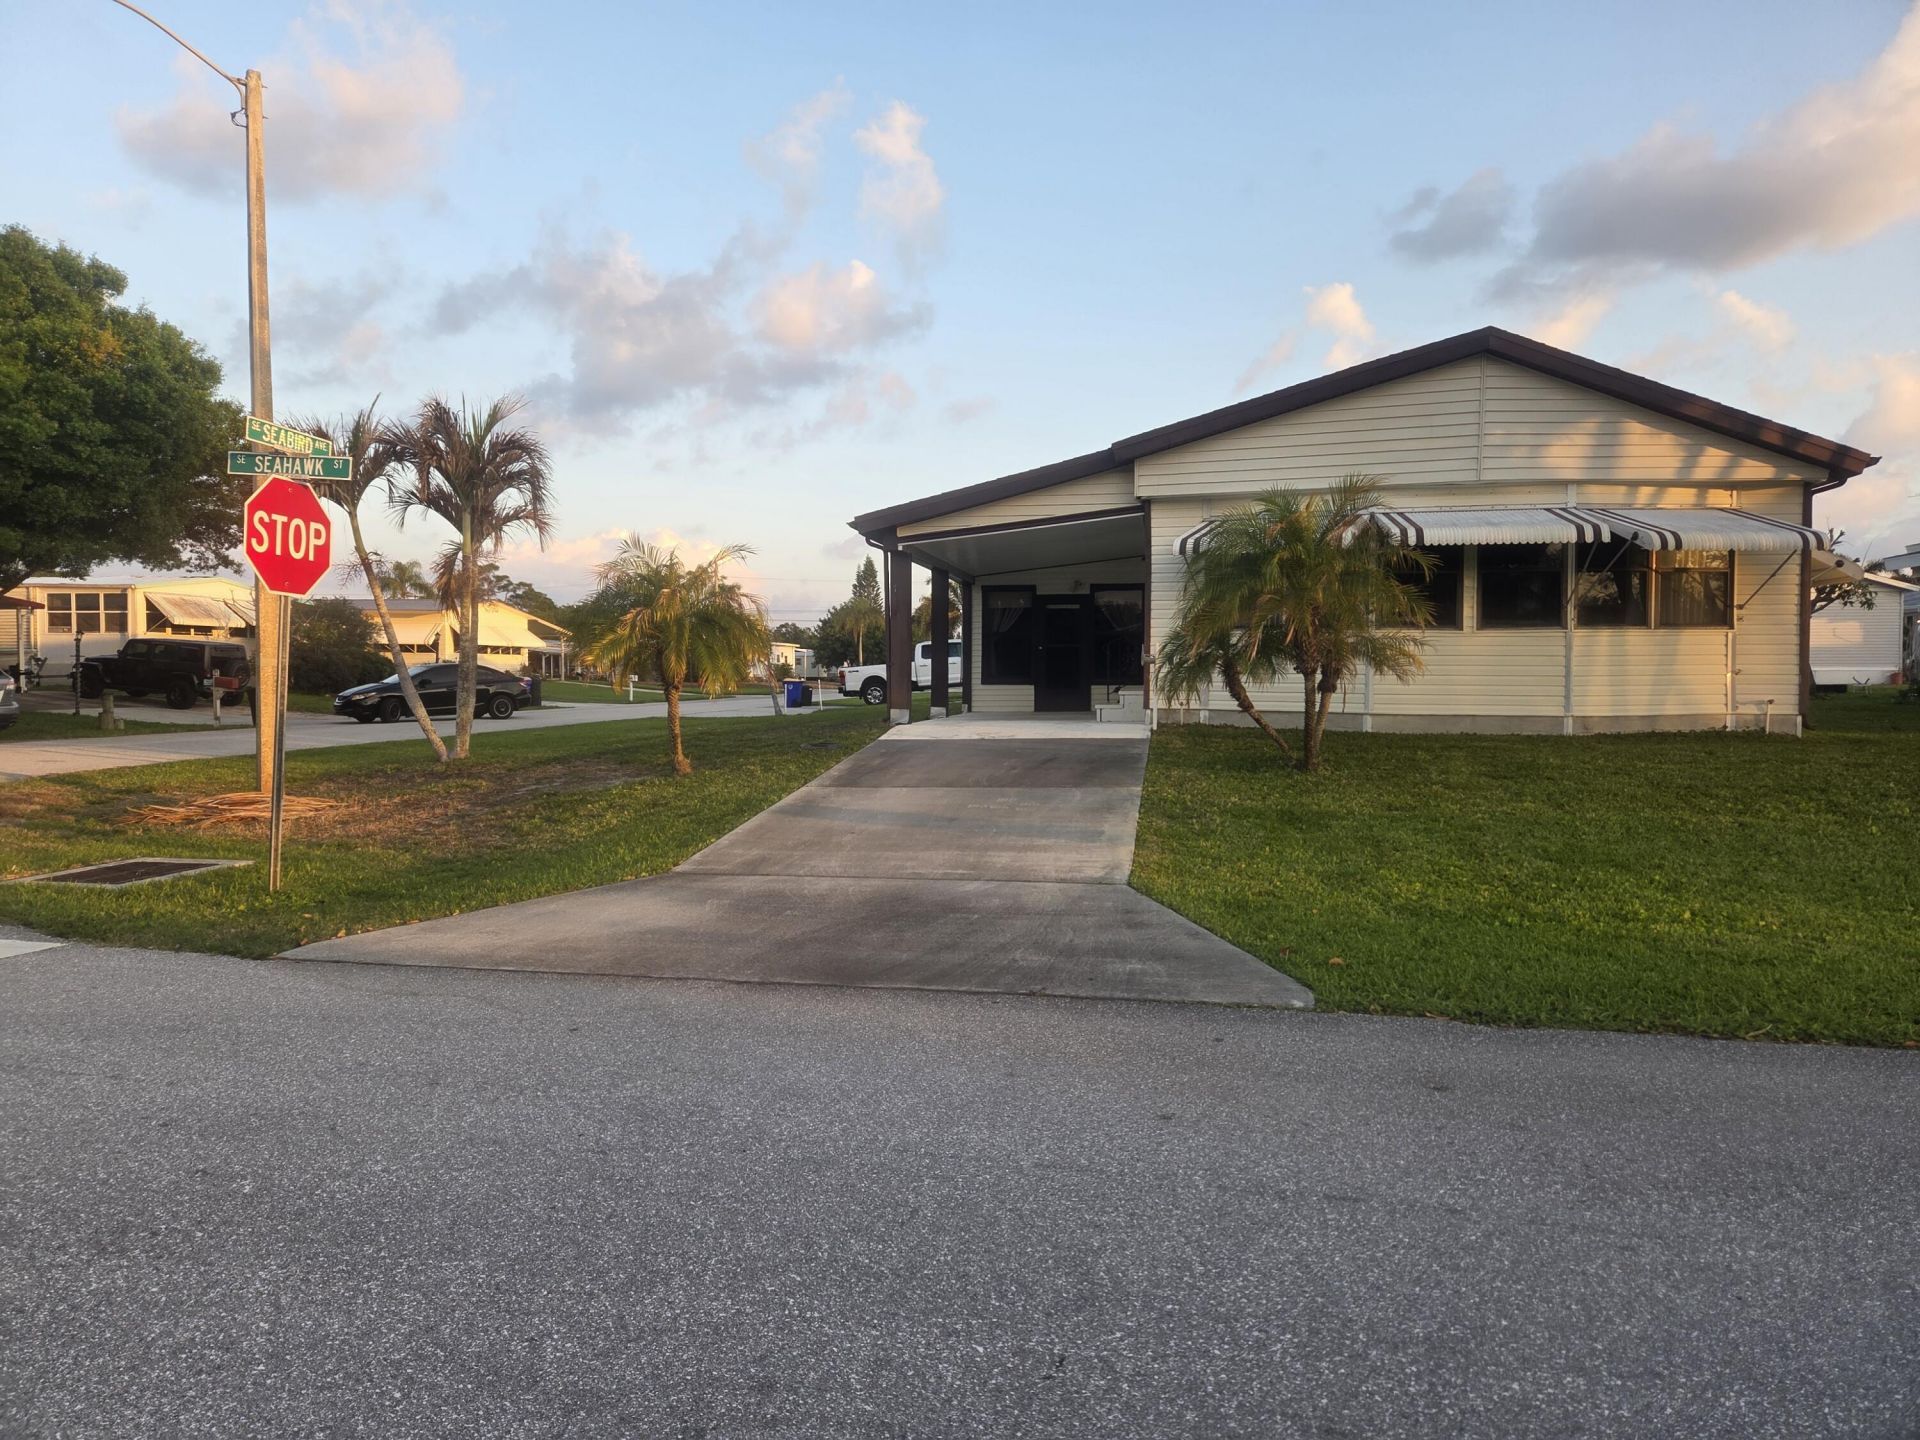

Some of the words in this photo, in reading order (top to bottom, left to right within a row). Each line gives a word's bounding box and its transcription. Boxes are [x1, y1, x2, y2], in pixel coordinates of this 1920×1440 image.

[251, 420, 261, 432] SE
[262, 424, 313, 454] SEABIRD
[236, 454, 246, 464] SE
[254, 456, 324, 476] SEAHAWK
[333, 459, 343, 469] ST
[251, 510, 327, 562] STOP
